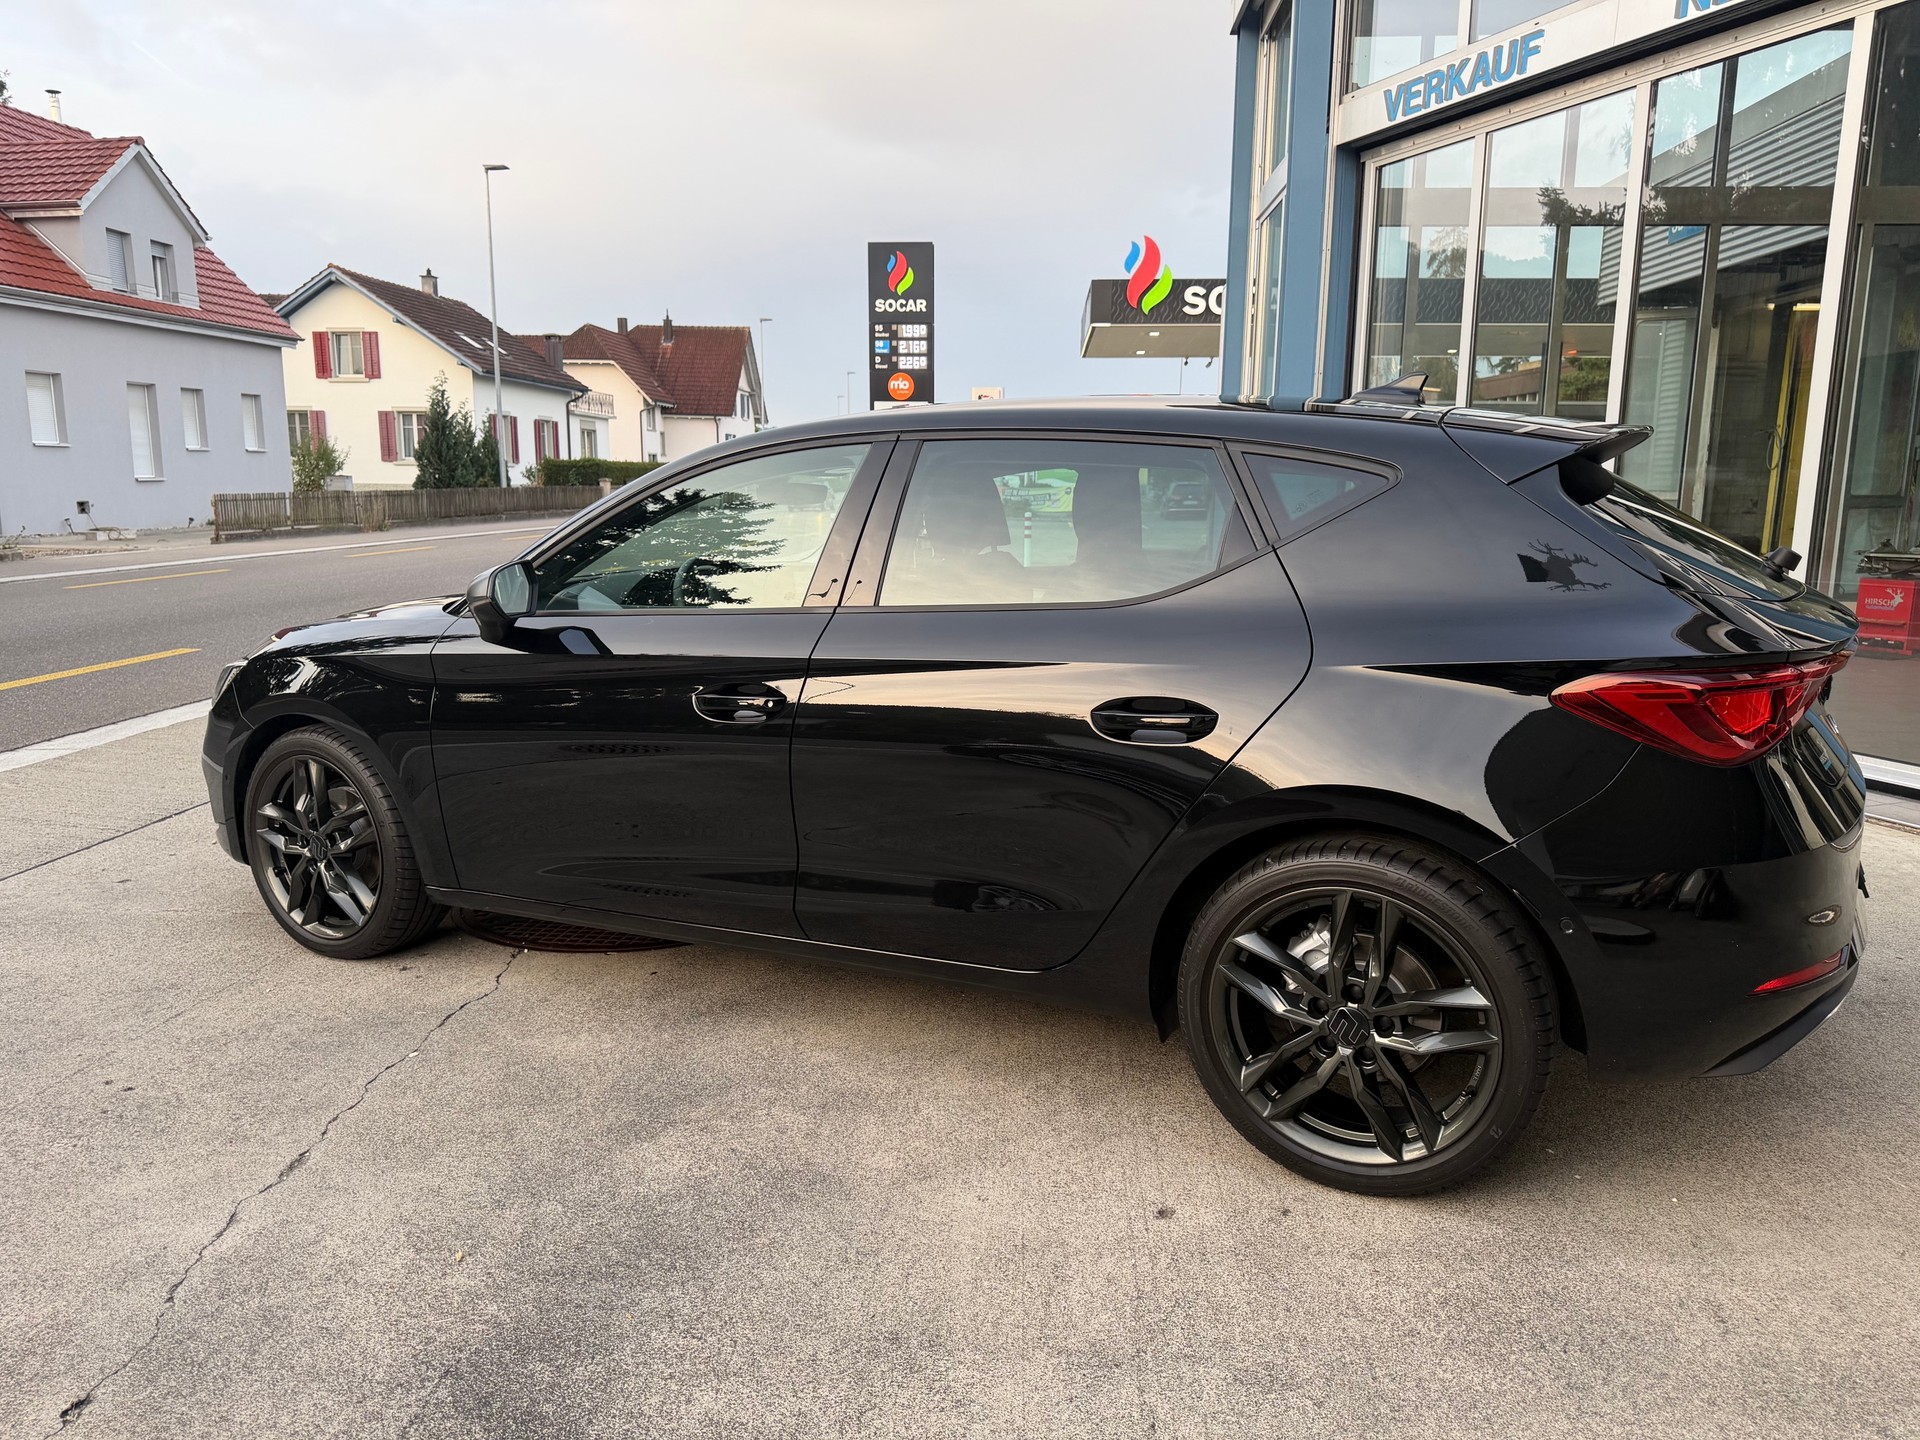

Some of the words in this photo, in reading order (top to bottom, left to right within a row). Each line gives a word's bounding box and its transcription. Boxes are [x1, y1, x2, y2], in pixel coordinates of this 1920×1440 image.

[1383, 29, 1545, 122] VERKAUF
[875, 299, 927, 312] SOCAR
[1865, 598, 1893, 606] HIRSCH
